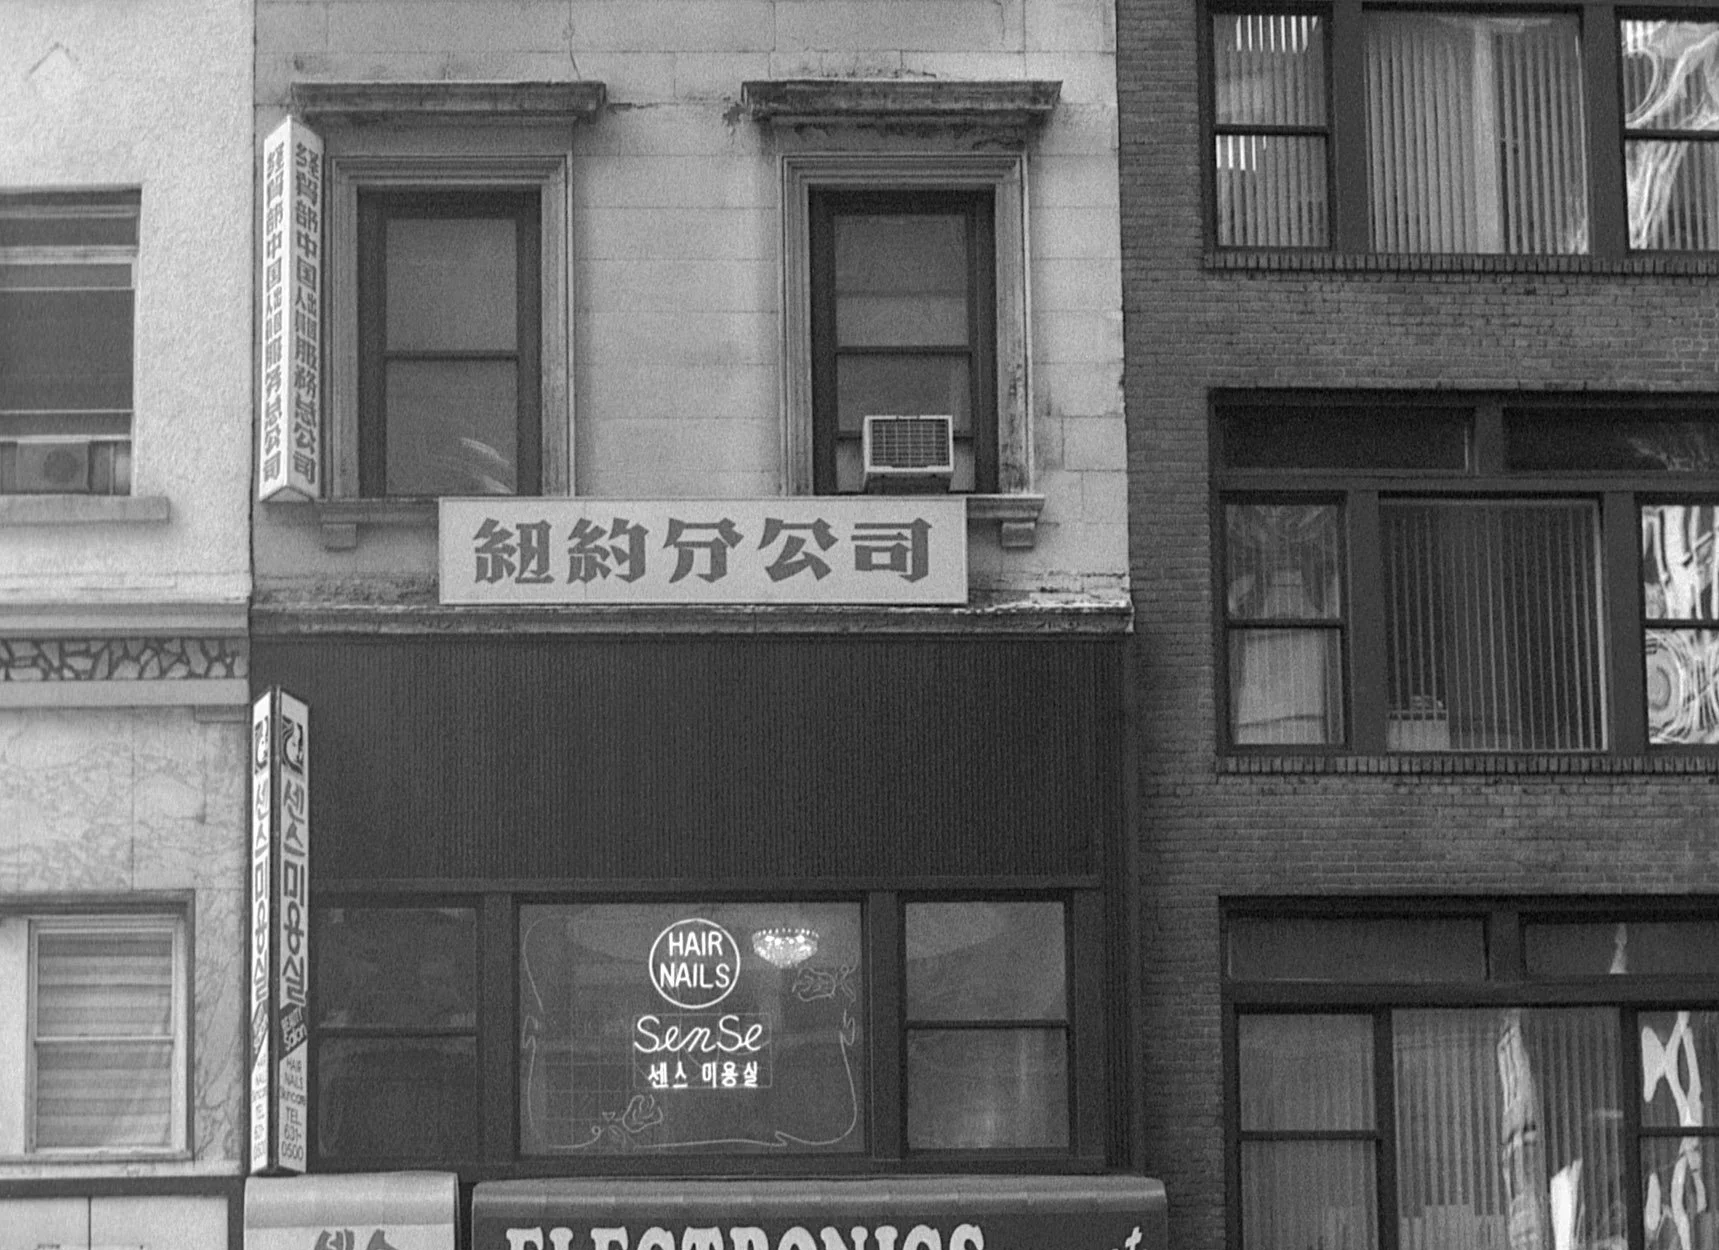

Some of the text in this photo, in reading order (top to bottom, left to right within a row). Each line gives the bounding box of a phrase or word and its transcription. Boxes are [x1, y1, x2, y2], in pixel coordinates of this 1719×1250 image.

[668, 931, 723, 956] HAIR
[660, 962, 730, 988] NAILS
[648, 1061, 759, 1089] 센스 미용실
